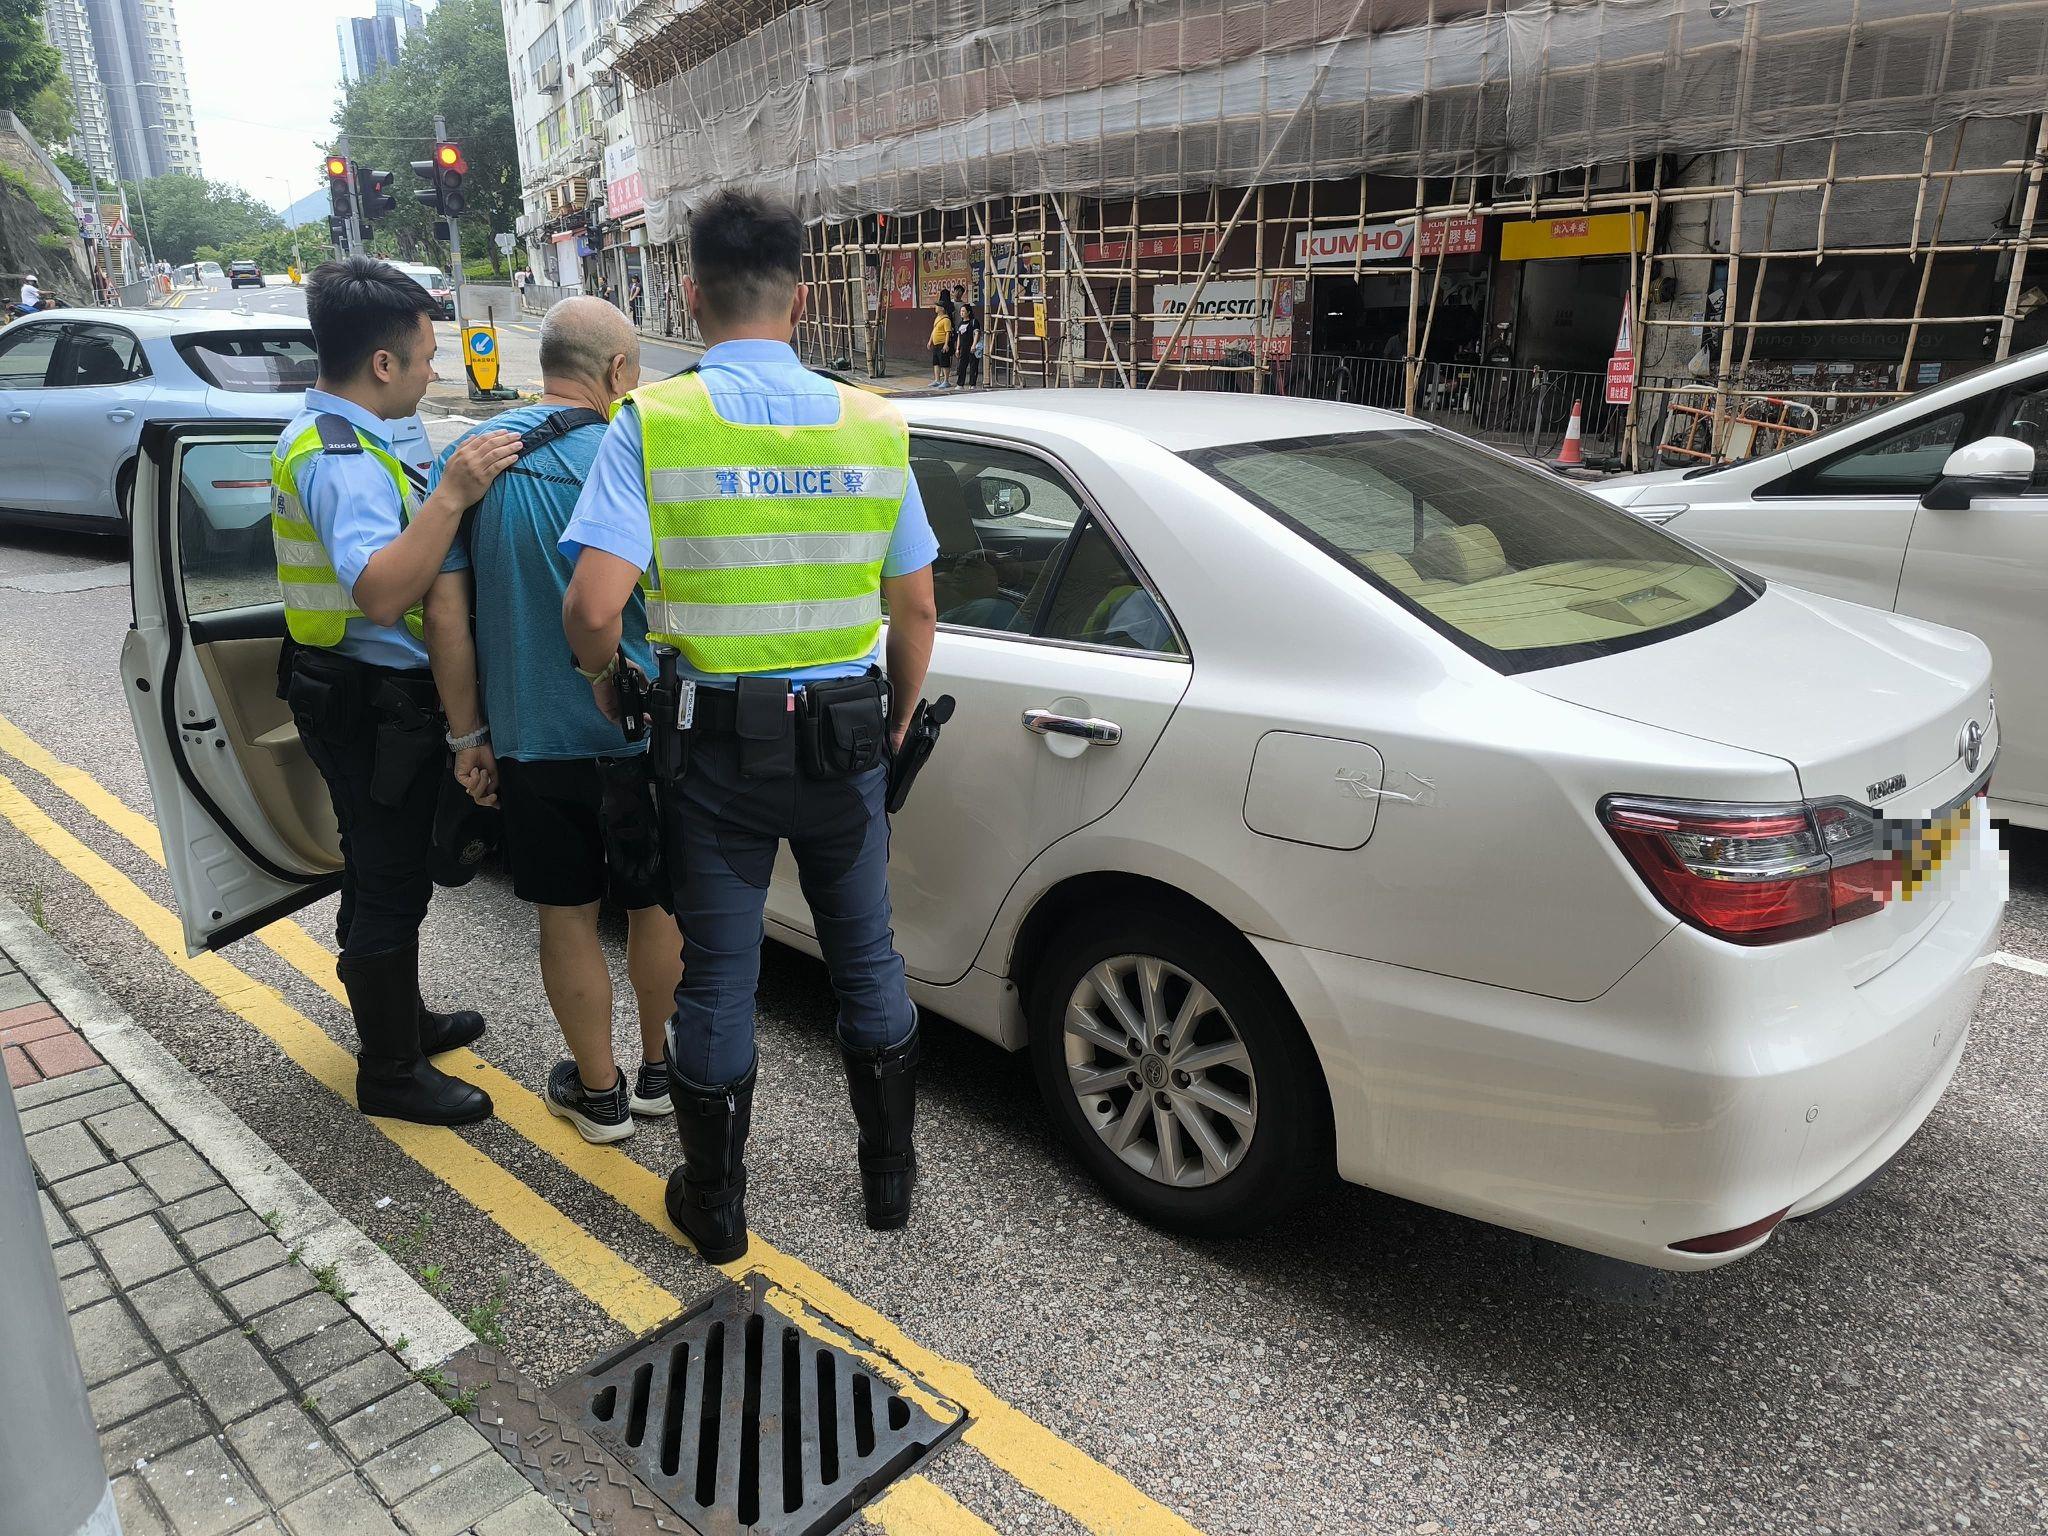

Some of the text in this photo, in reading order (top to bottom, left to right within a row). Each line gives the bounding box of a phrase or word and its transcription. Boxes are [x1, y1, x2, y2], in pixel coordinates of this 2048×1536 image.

[1459, 218, 1477, 226] TIRE
[1301, 230, 1403, 256] KUMHO
[1801, 331, 1823, 347] by
[1829, 329, 1944, 347] technolgy
[1613, 361, 1630, 371] REDUCE
[1609, 375, 1622, 384] SPEED
[716, 471, 738, 494] 警
[749, 470, 832, 494] POLICE
[844, 470, 864, 493] 察
